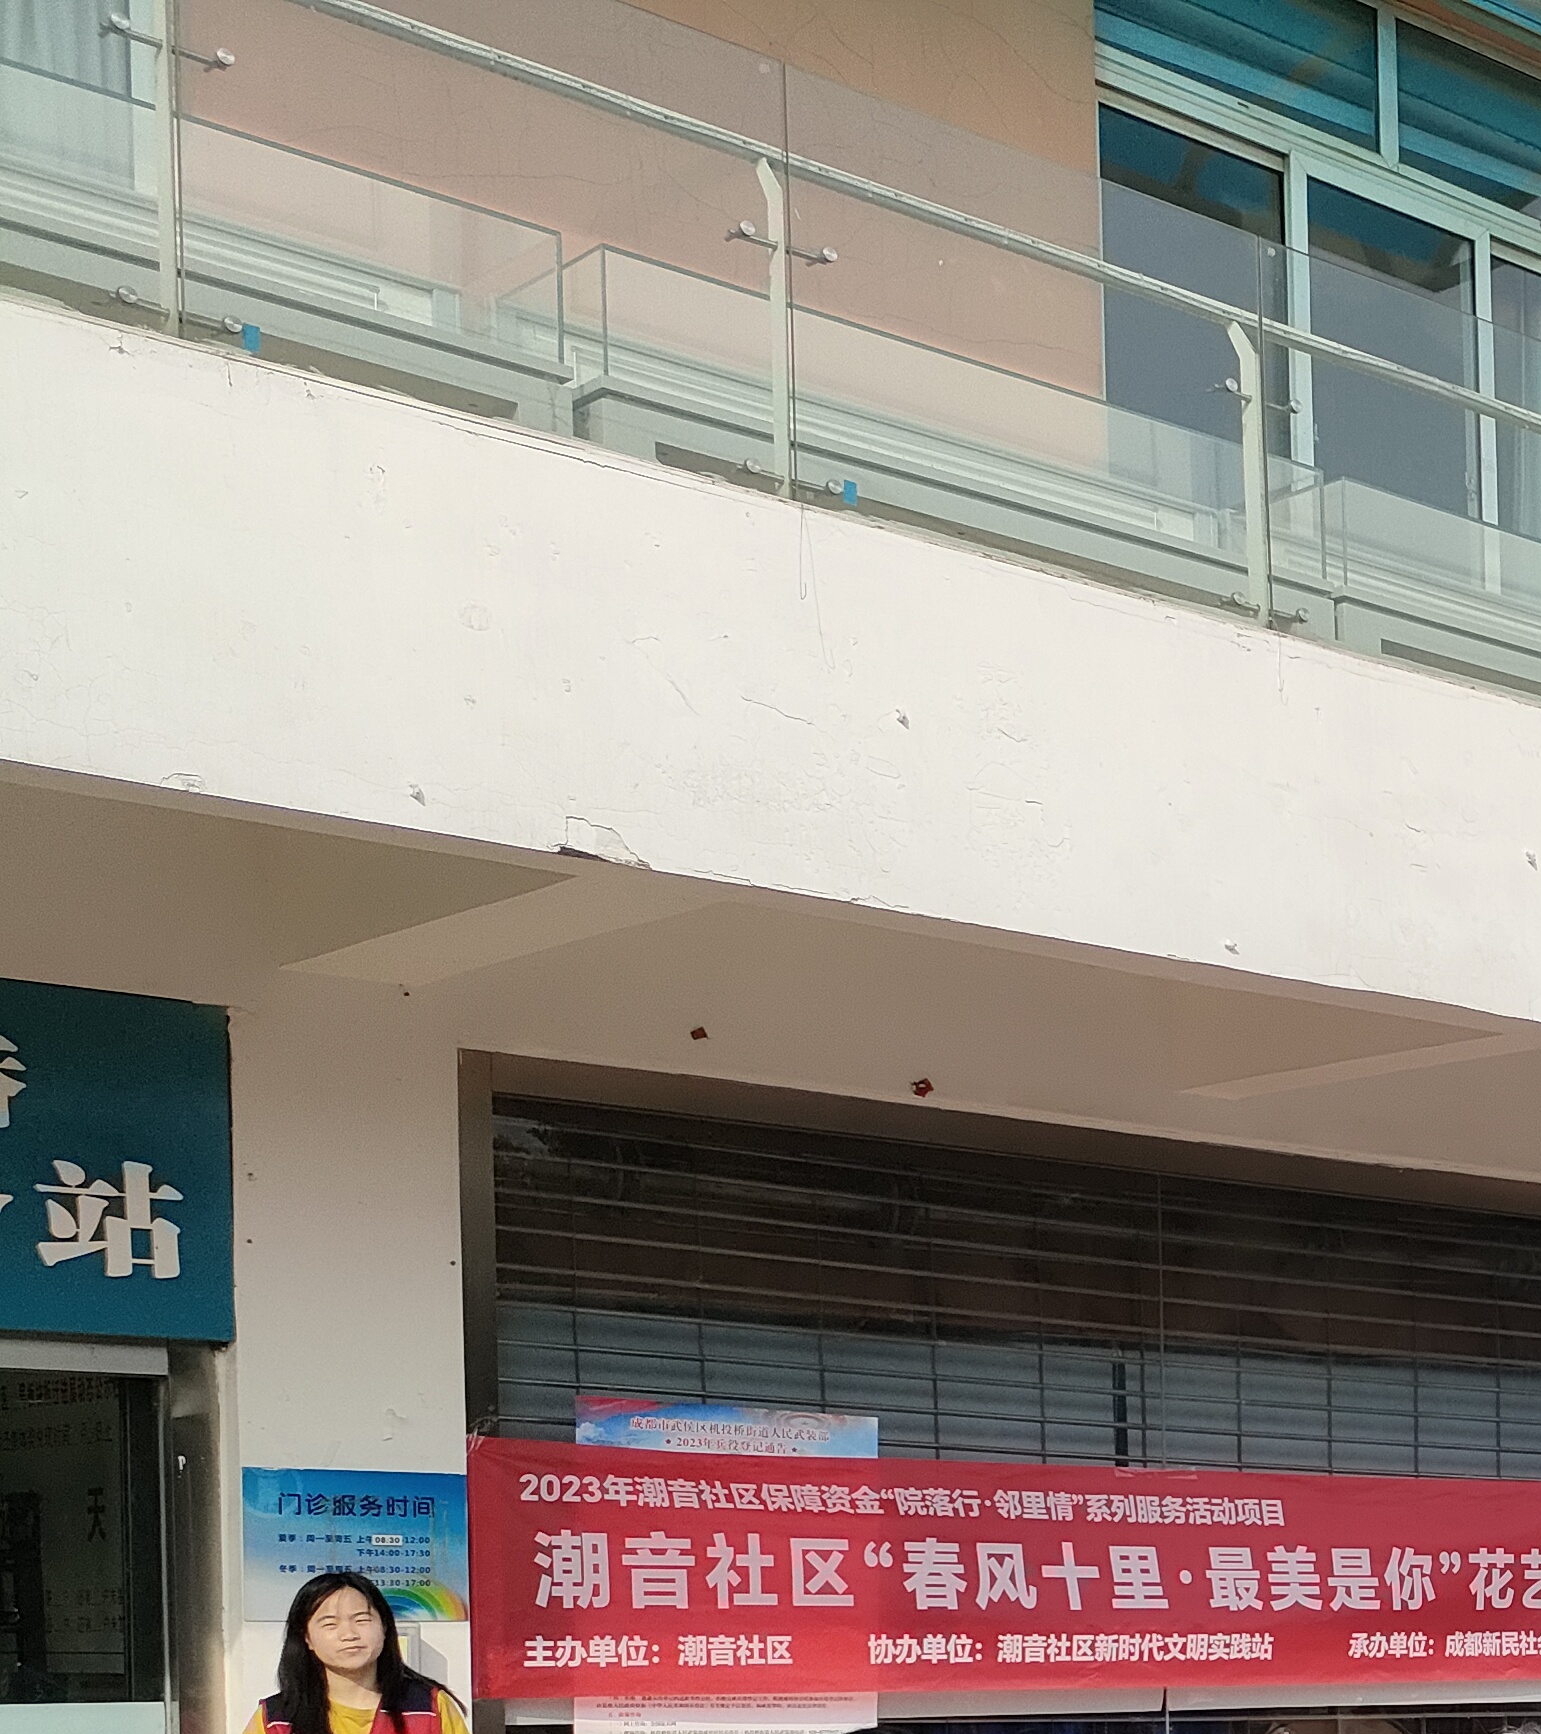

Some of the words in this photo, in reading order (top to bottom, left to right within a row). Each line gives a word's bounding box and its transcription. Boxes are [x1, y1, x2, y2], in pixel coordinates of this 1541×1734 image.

[0, 1160, 184, 1279] 站
[629, 1416, 830, 1443] 成都市武侯区机投桥街道人民武装部
[277, 1492, 435, 1519] 门诊服务时间
[356, 1549, 431, 1558] 下午14:00-17:30
[524, 1634, 793, 1669] 主办单位：潮音社区
[868, 1633, 1274, 1665] 协办单位：潮音社区新时代文明实践站
